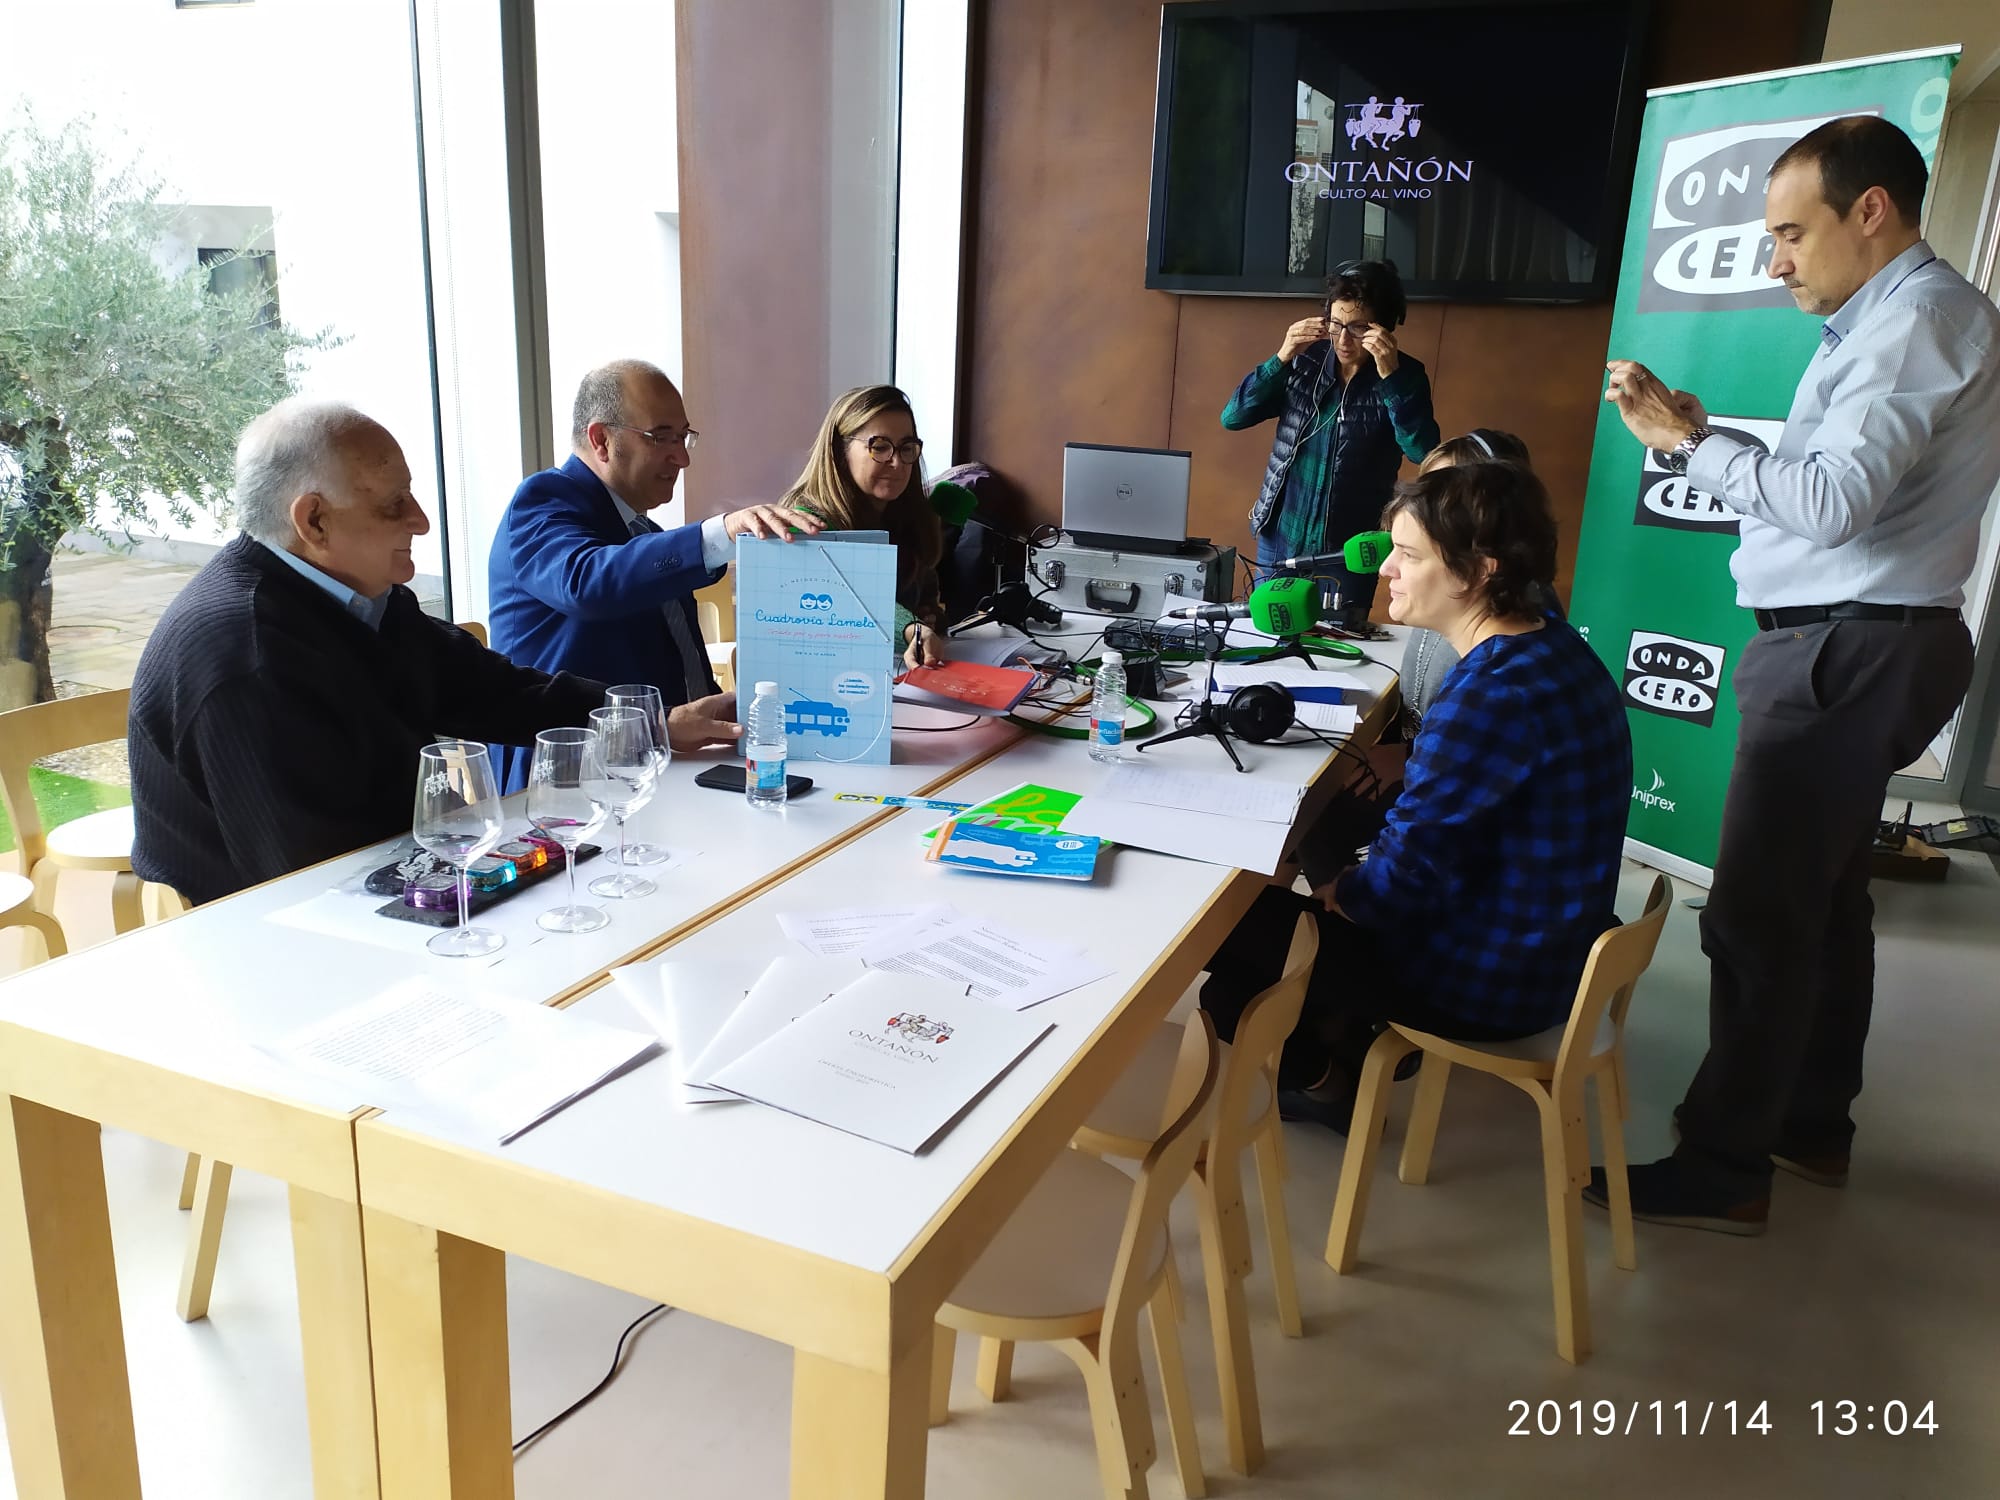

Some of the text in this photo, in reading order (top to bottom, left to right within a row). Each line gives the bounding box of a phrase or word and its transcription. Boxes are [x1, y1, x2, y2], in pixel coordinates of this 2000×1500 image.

[1284, 156, 1474, 183] ONTAÑÓN
[1318, 188, 1432, 199] CULTO AL VINO
[1682, 164, 1773, 206] ON
[1678, 234, 1774, 280] CER
[1661, 482, 1724, 512] CER
[1640, 648, 1706, 676] ONDA
[1639, 679, 1701, 707] CERO
